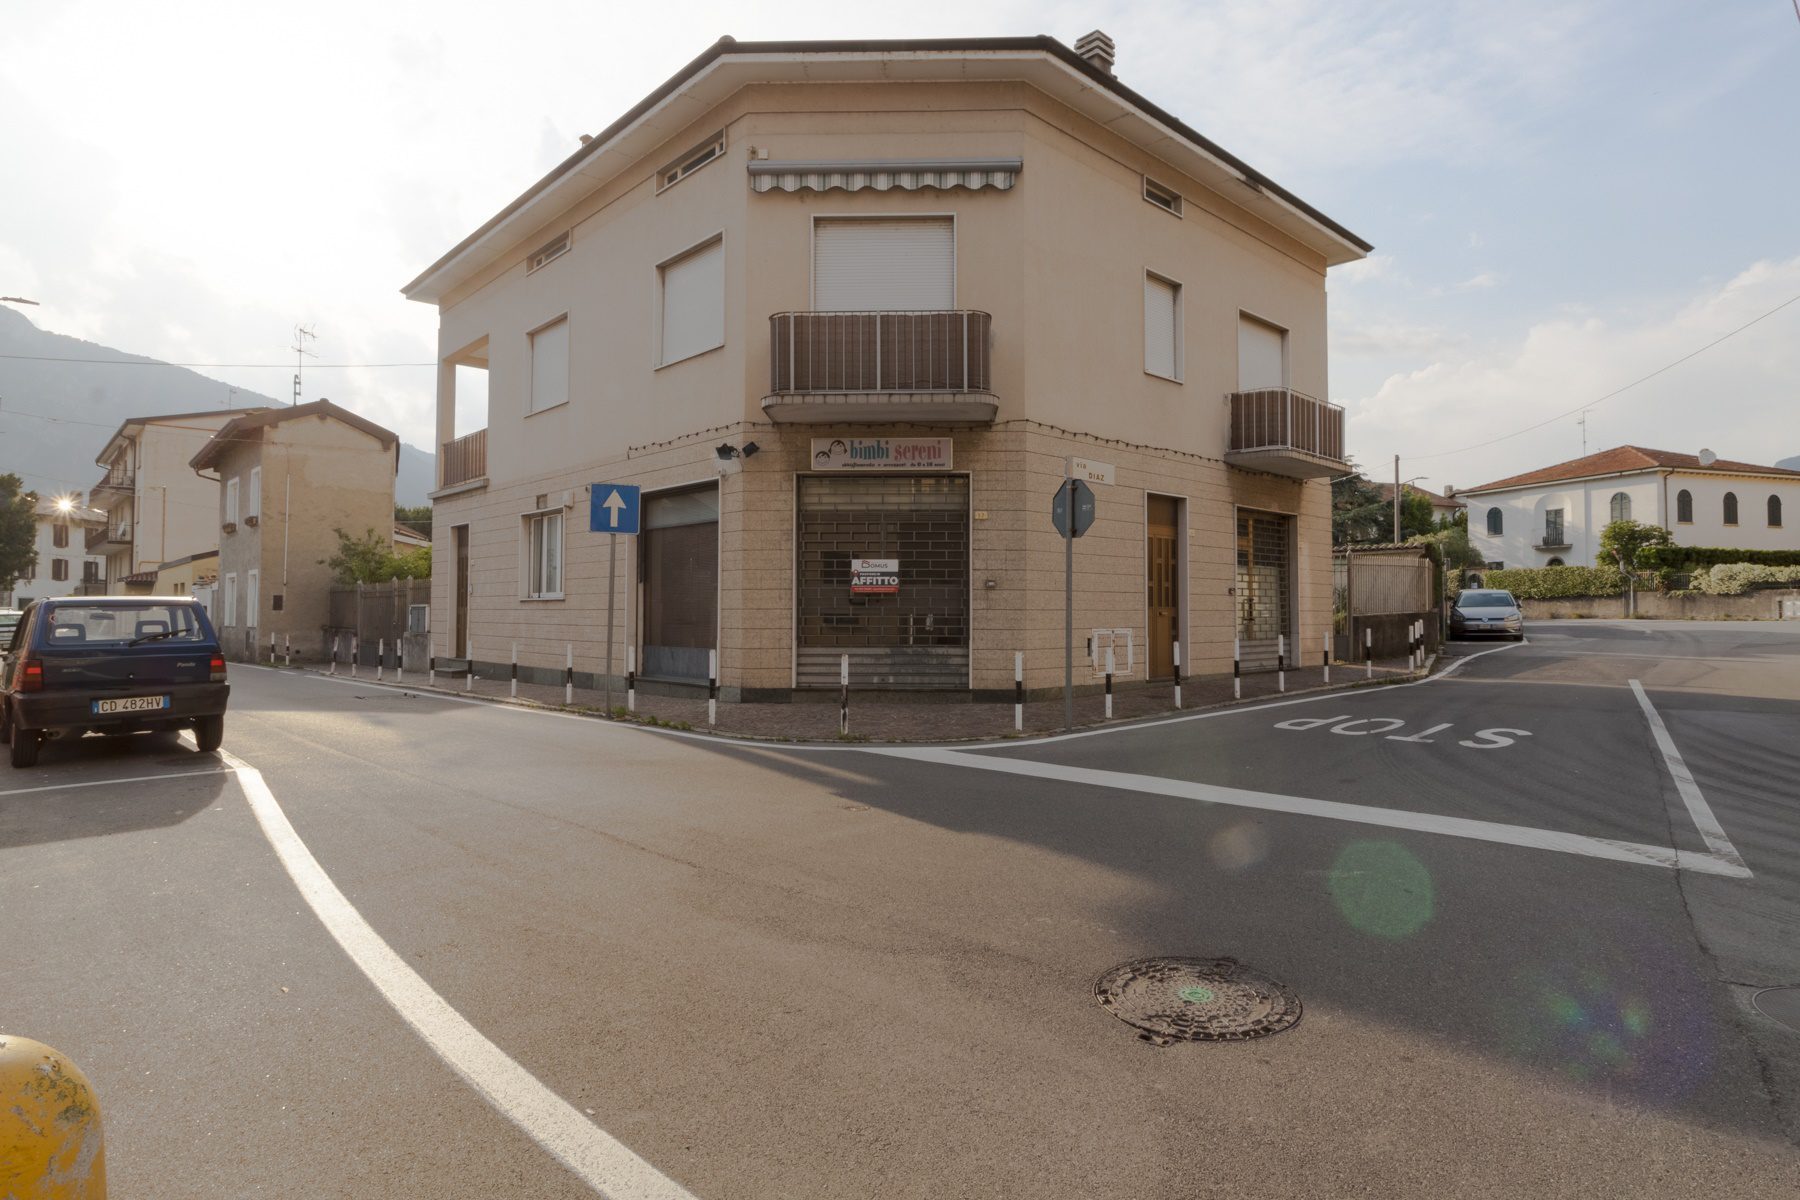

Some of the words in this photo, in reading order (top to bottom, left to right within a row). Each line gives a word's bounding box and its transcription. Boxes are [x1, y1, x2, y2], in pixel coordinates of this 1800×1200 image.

[850, 440, 889, 460] bimbi
[894, 440, 942, 461] sereni
[1088, 472, 1105, 481] DIAZ
[851, 576, 899, 585] AFFITTO
[101, 700, 117, 712] CD
[123, 698, 161, 710] 482HV
[1273, 715, 1533, 749] STOP
